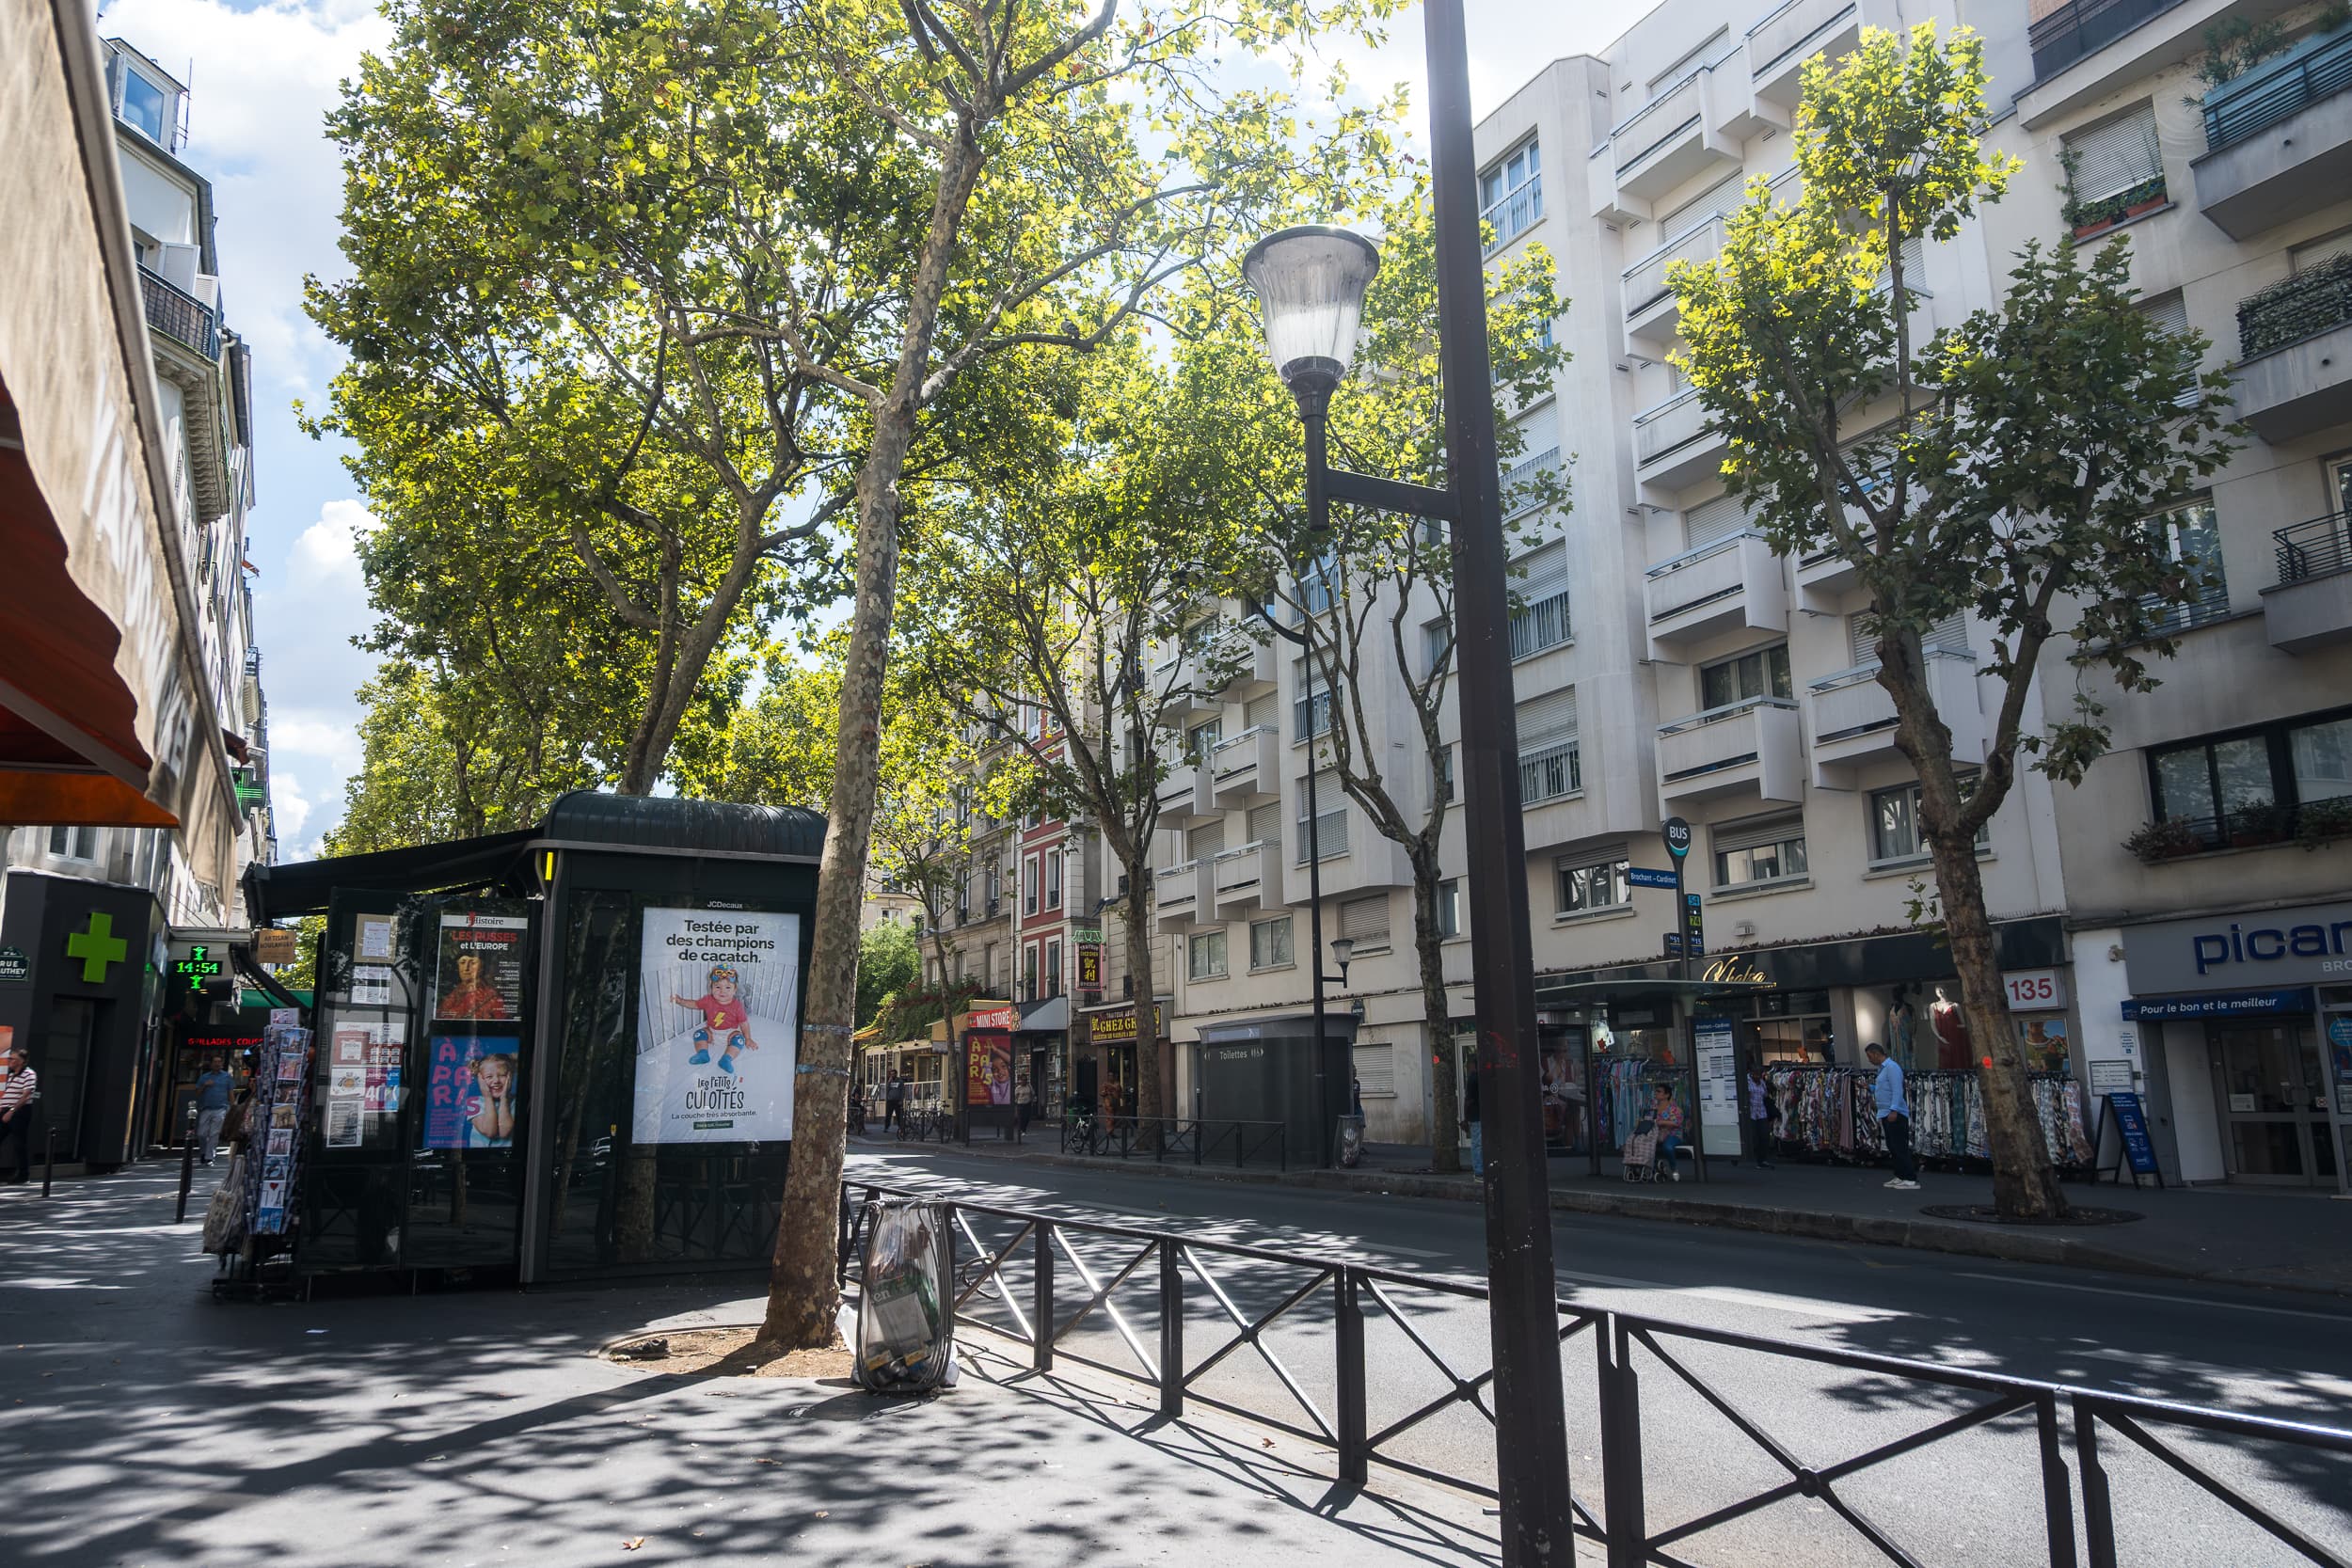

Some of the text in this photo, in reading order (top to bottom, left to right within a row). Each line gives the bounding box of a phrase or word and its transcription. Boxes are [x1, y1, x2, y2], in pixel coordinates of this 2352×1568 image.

[1669, 826, 1688, 839] BUS
[1630, 873, 1652, 882] Brochant
[1656, 875, 1677, 884] Cardinet
[707, 900, 743, 909] JCDecaux
[684, 919, 759, 937] Testée par
[1691, 916, 1700, 926] 74
[452, 930, 517, 942] LES RUSSES
[666, 933, 775, 951] des champions
[469, 942, 509, 951] L'EUROPE
[2194, 921, 2352, 974] picar
[678, 948, 761, 962] de cacatch.
[177, 962, 218, 973] 14:54
[2323, 959, 2352, 973] BRO
[2009, 978, 2053, 1001] 135
[2140, 1005, 2164, 1015] Pour
[2167, 1004, 2176, 1013] le
[2180, 1002, 2200, 1012] bon
[2203, 1002, 2215, 1010] et
[2217, 1000, 2227, 1009] le
[2231, 998, 2278, 1008] meilleur
[977, 1010, 1009, 1028] MINI STORE
[438, 1037, 456, 1062] À
[971, 1037, 981, 1053] À
[1219, 1050, 1248, 1060] Toilettes
[698, 1076, 731, 1090] LES PETITS
[686, 1087, 745, 1109] CULOTTÉS
